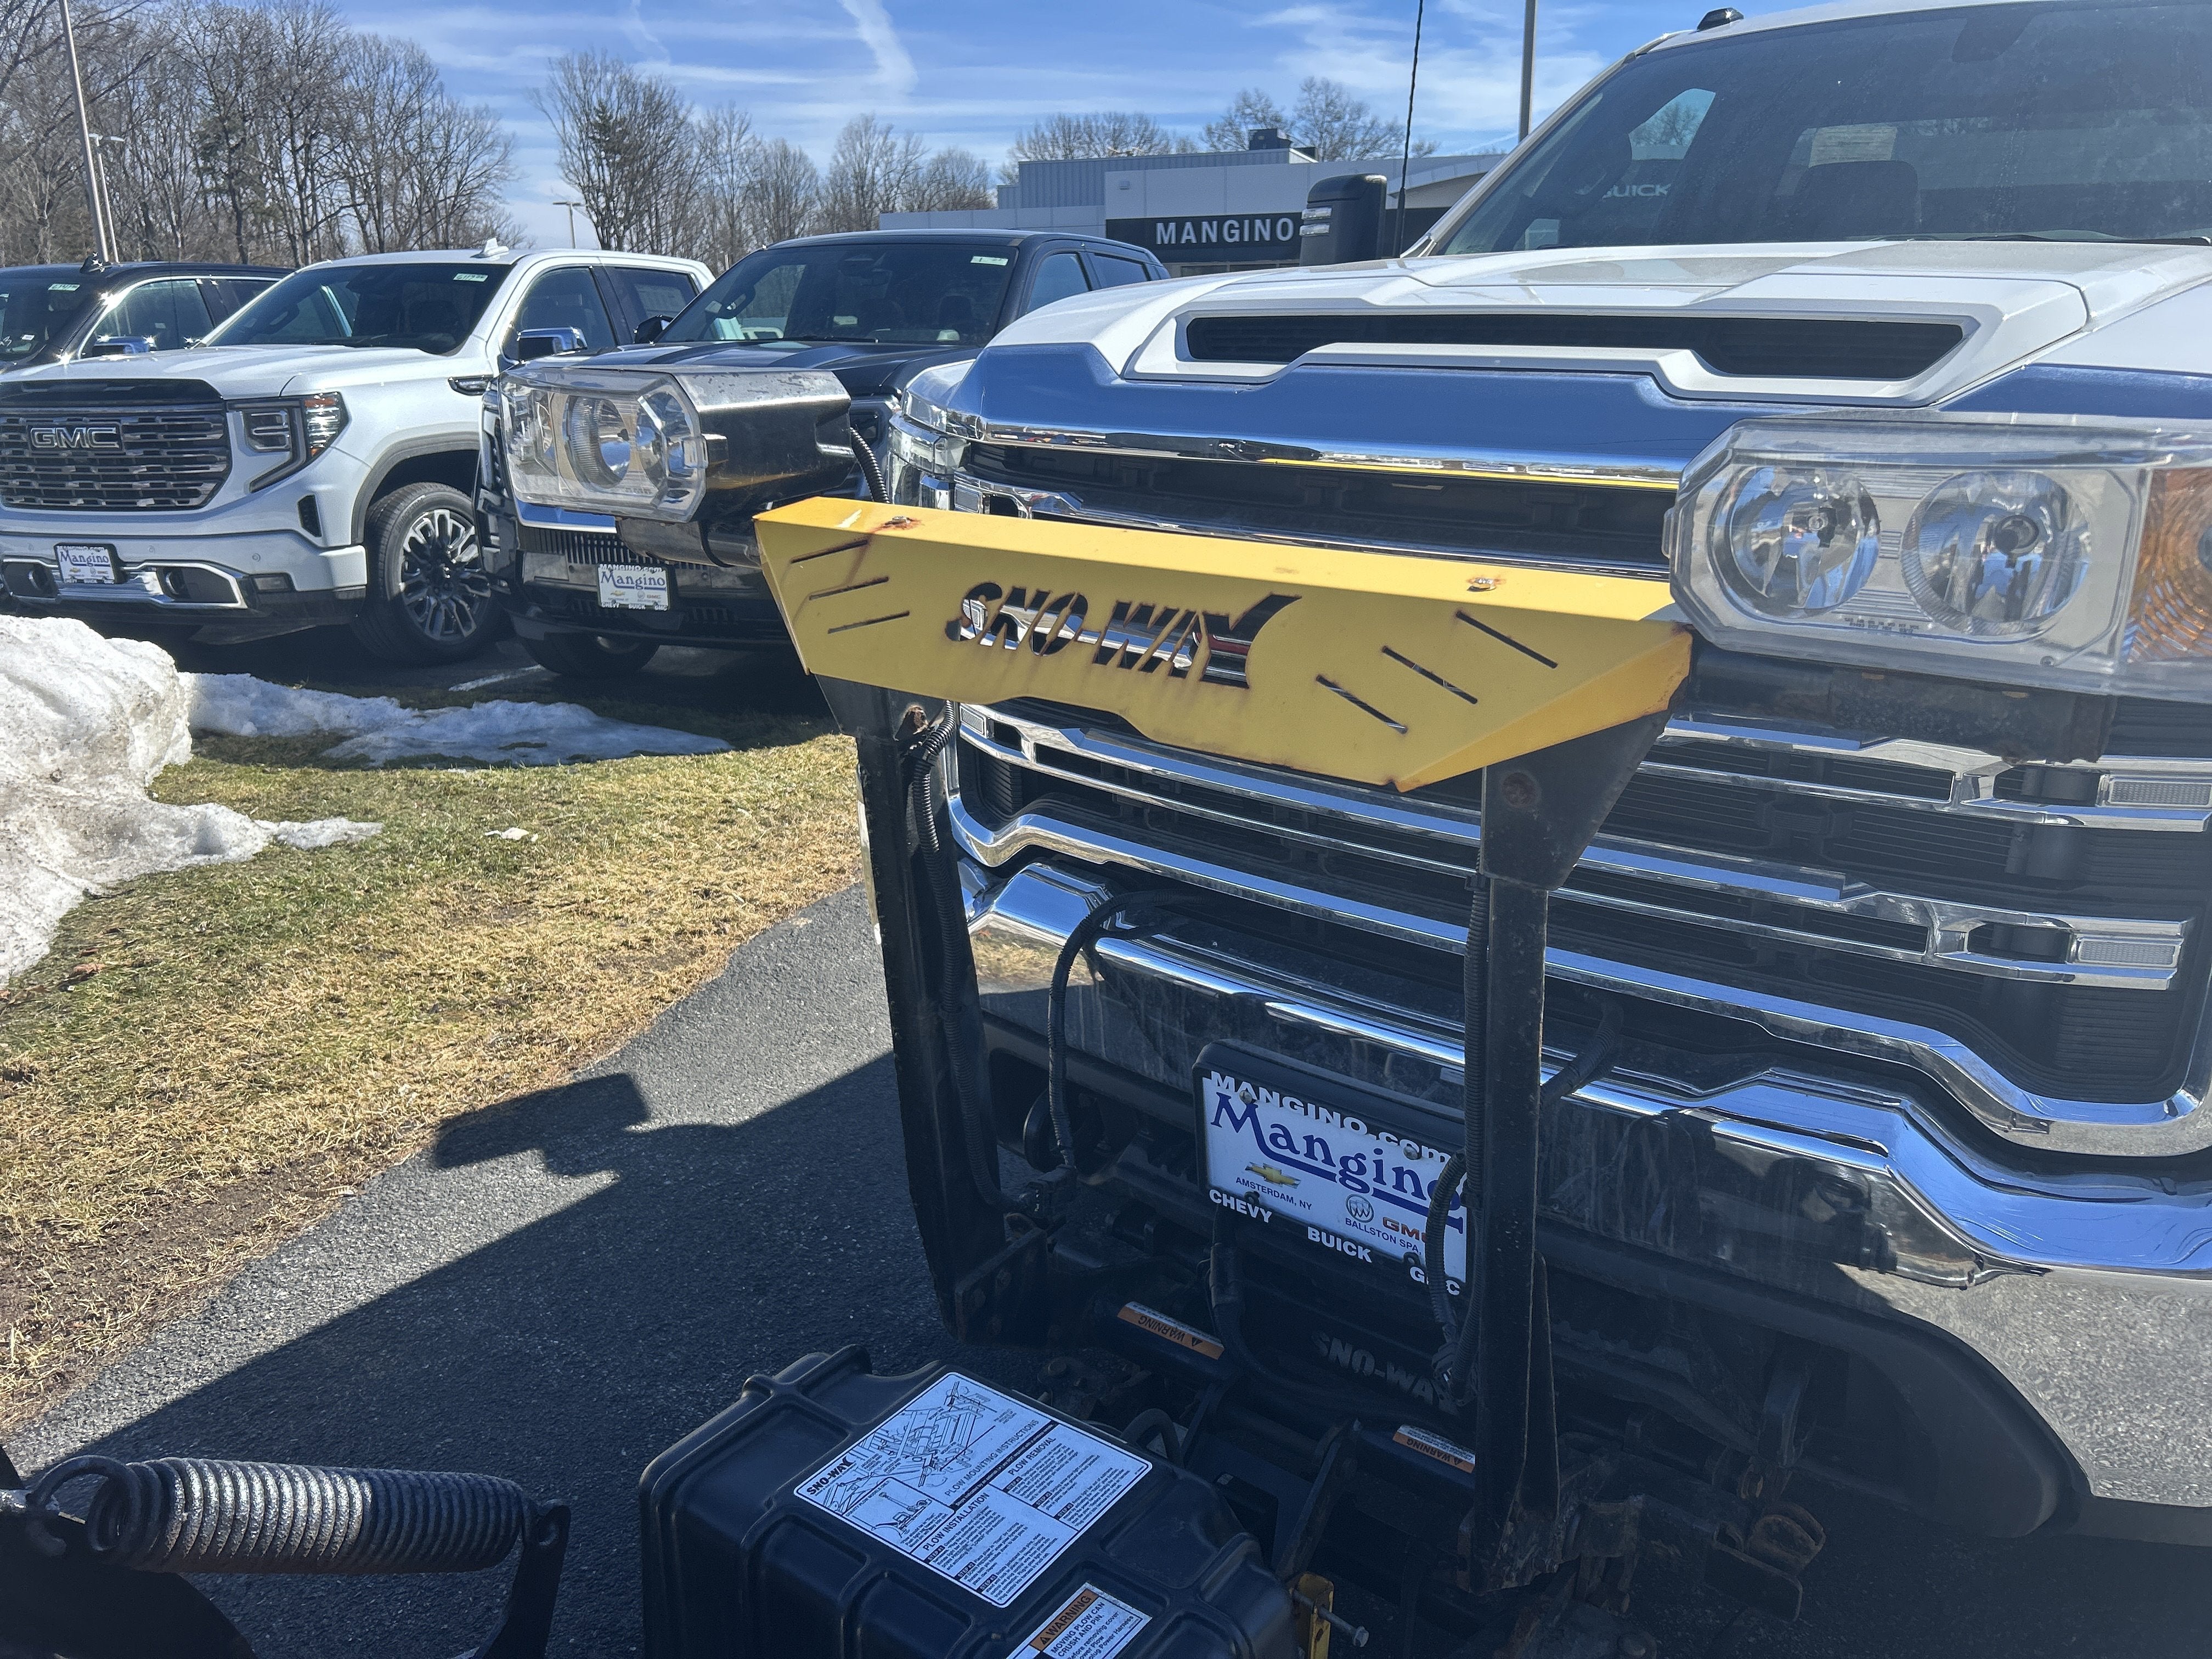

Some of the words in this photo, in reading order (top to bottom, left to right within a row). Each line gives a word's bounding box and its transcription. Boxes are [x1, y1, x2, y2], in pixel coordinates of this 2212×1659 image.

[1155, 217, 1294, 245] MANGINO
[30, 427, 120, 448] GMC
[60, 549, 110, 567] Mangino
[601, 571, 666, 590] Mangino
[945, 582, 1302, 689] SNO-WAY
[1211, 1070, 1451, 1163] MANGINO.com
[1235, 1177, 1297, 1206] AMSTERDAM,
[1299, 1200, 1312, 1210] NY
[1209, 1189, 1272, 1223] CHEVY
[1307, 1226, 1372, 1263] BUICK
[1409, 1266, 1460, 1296] GC
[1345, 1217, 1396, 1244] BALLSTON
[1400, 1239, 1421, 1255] SPA,
[1383, 1217, 1426, 1243] GM
[1138, 1316, 1186, 1342] WARNING
[943, 1478, 968, 1497] PLOW
[962, 1452, 999, 1481] MOUNTING
[994, 1418, 1040, 1454] INSTRUCTIONS
[1007, 1458, 1030, 1476] PLOW
[1024, 1435, 1057, 1460] REMOVAL
[1407, 1438, 1451, 1462] WARNING
[806, 1455, 856, 1495] SNO-WAY
[921, 1531, 947, 1551] PLOW
[940, 1492, 991, 1533] INSTALLATION
[1047, 1595, 1092, 1637] WARNING
[1051, 1630, 1076, 1654] MOVING
[1074, 1613, 1092, 1631] PLOW
[1091, 1601, 1105, 1614] CAN
[1084, 1624, 1108, 1646] removing
[1105, 1611, 1120, 1626] cover
[1099, 1633, 1115, 1649] Power
[1114, 1616, 1134, 1635] Harness
[1058, 1635, 1080, 1657] CRUSH
[1079, 1624, 1093, 1638] AND
[1090, 1614, 1105, 1625] PIN.
[1079, 1647, 1093, 1659] ower
